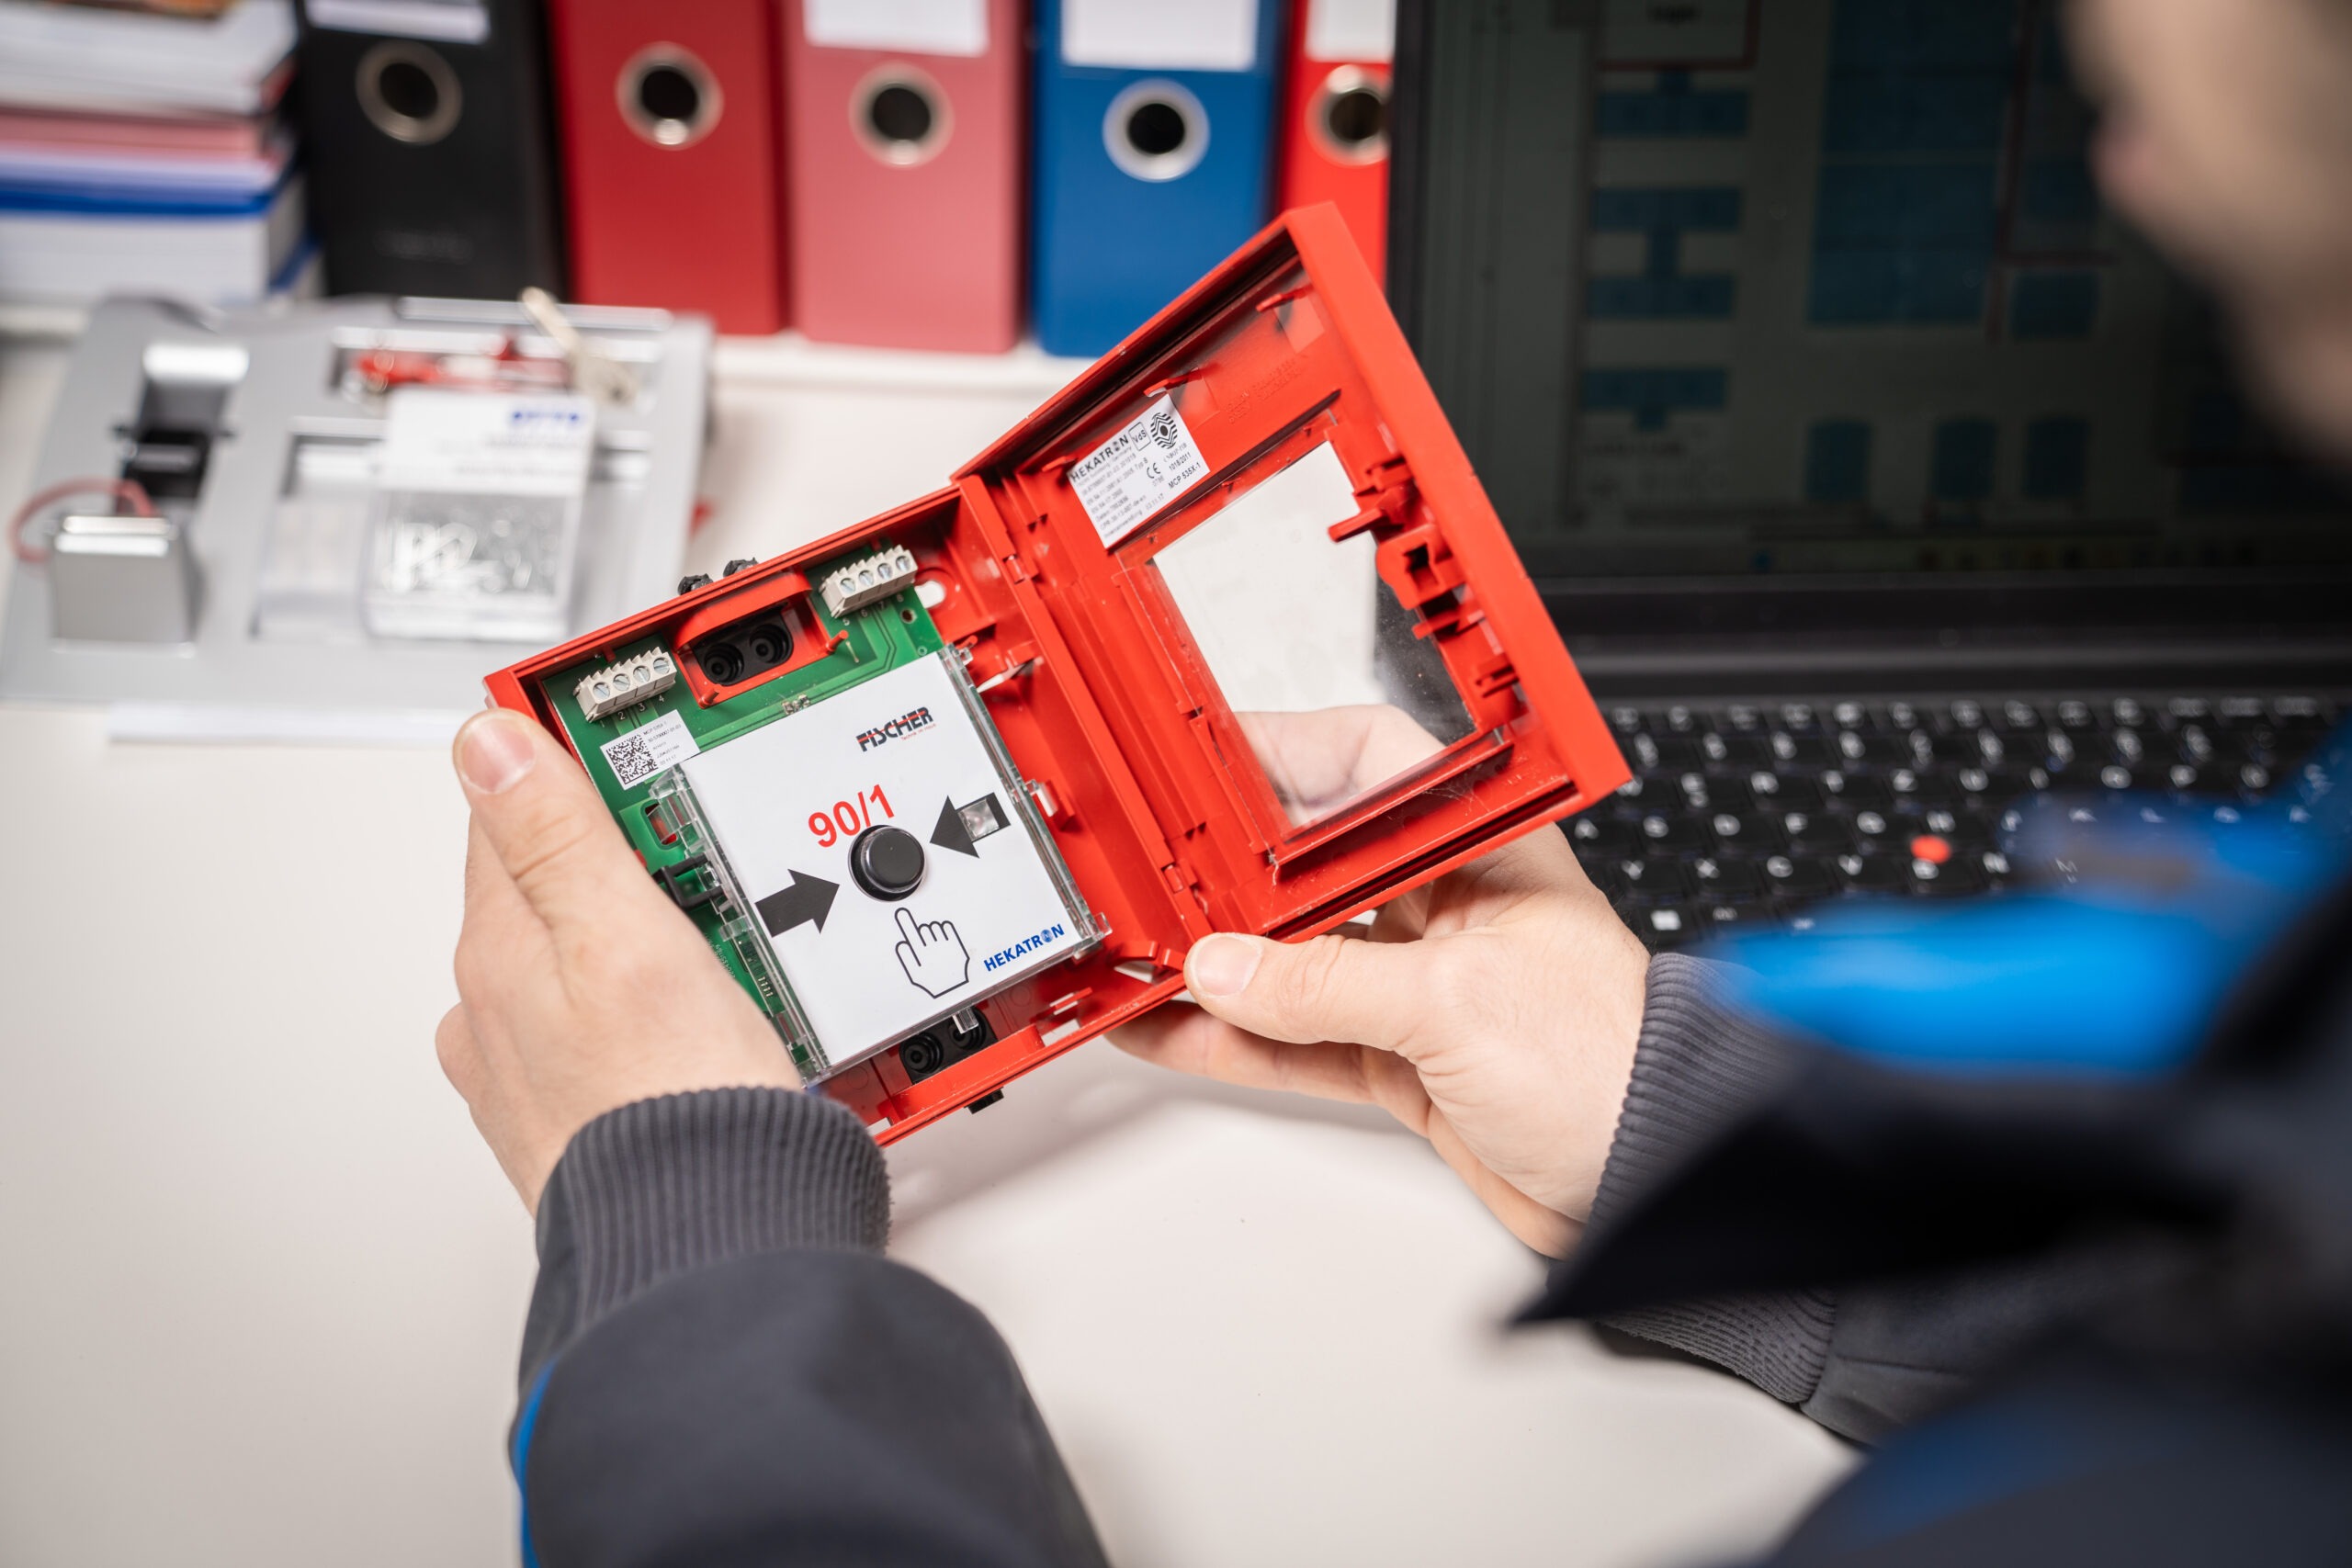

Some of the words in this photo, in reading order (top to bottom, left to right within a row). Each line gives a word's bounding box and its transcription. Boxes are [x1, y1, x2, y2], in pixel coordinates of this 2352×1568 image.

[1132, 429, 1147, 444] VdS
[1168, 475, 1182, 489] MCP
[617, 711, 626, 720] 2
[639, 703, 646, 712] 3
[855, 706, 933, 752] FISCHER
[808, 784, 895, 848] 90/1
[983, 923, 1065, 972] HEKATRON
